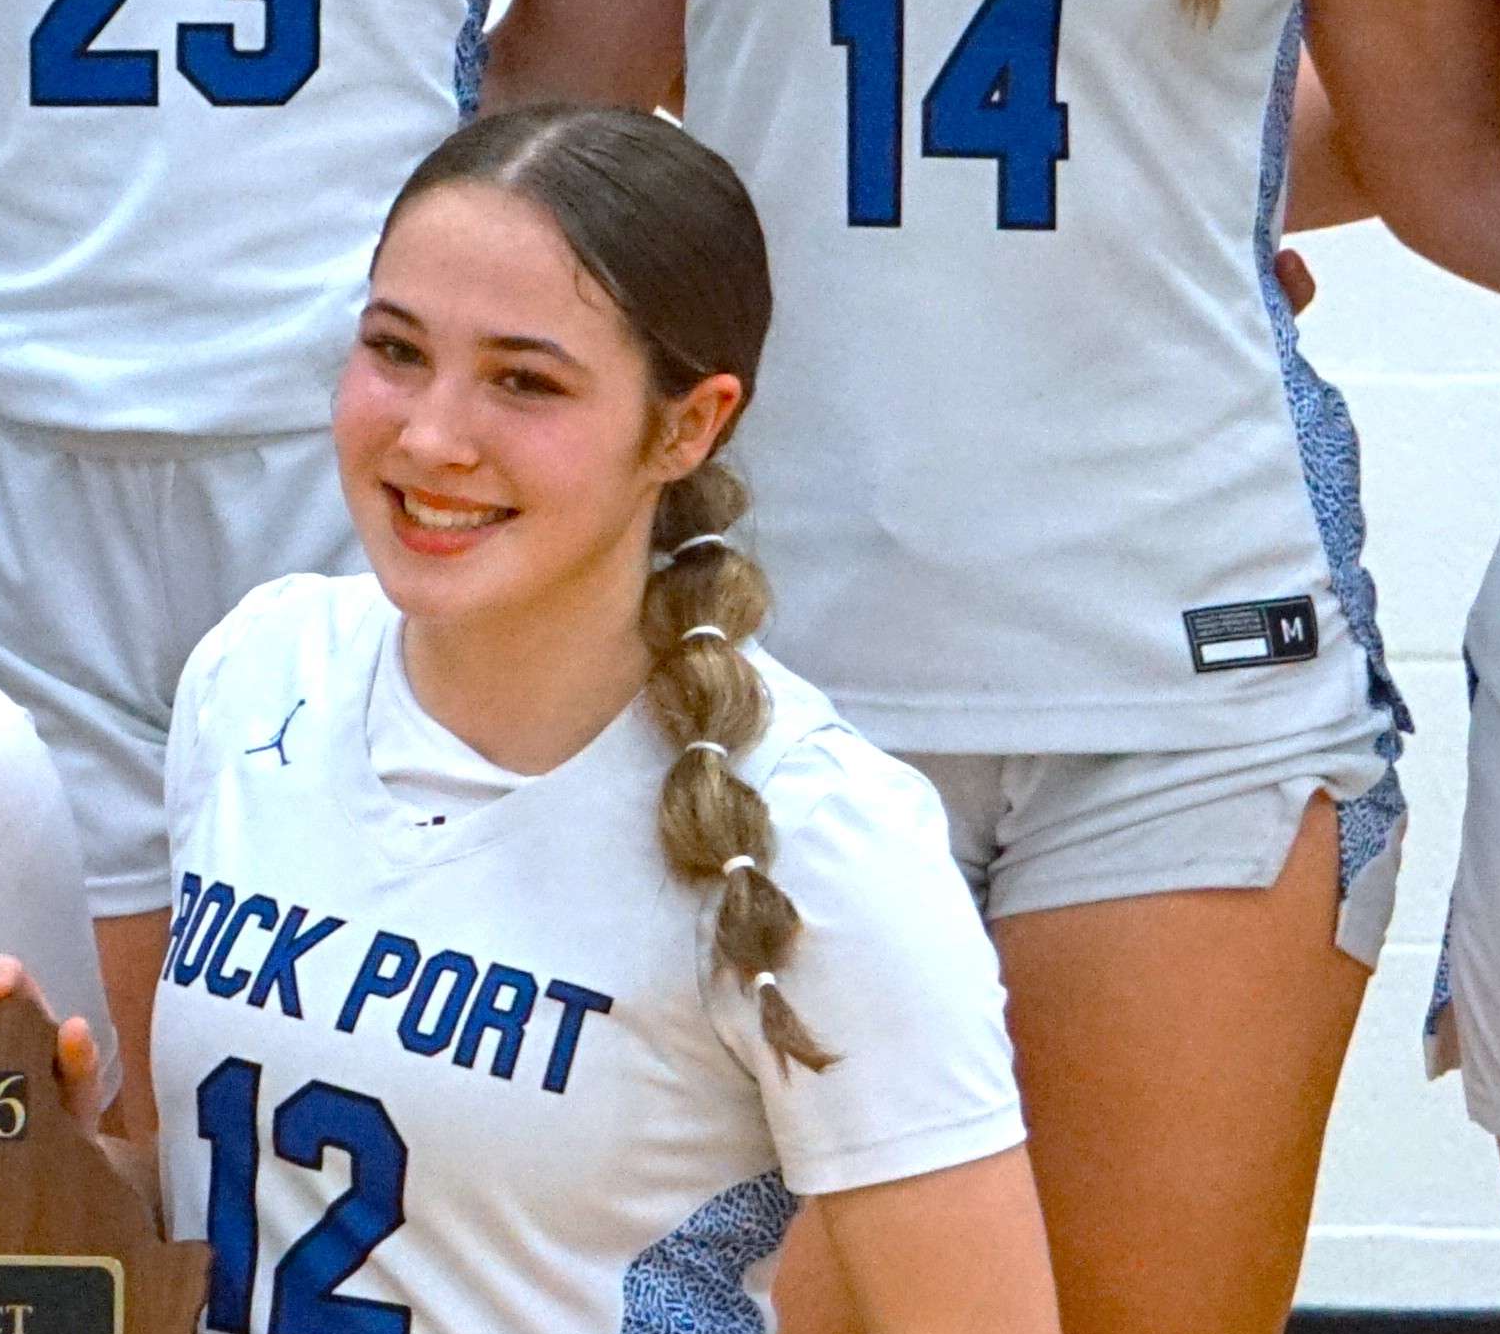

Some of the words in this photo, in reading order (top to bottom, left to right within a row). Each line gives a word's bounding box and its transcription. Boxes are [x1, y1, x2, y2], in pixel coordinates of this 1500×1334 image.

[1280, 616, 1305, 644] M
[164, 872, 348, 1020] ROCK
[335, 930, 614, 1095] PORT
